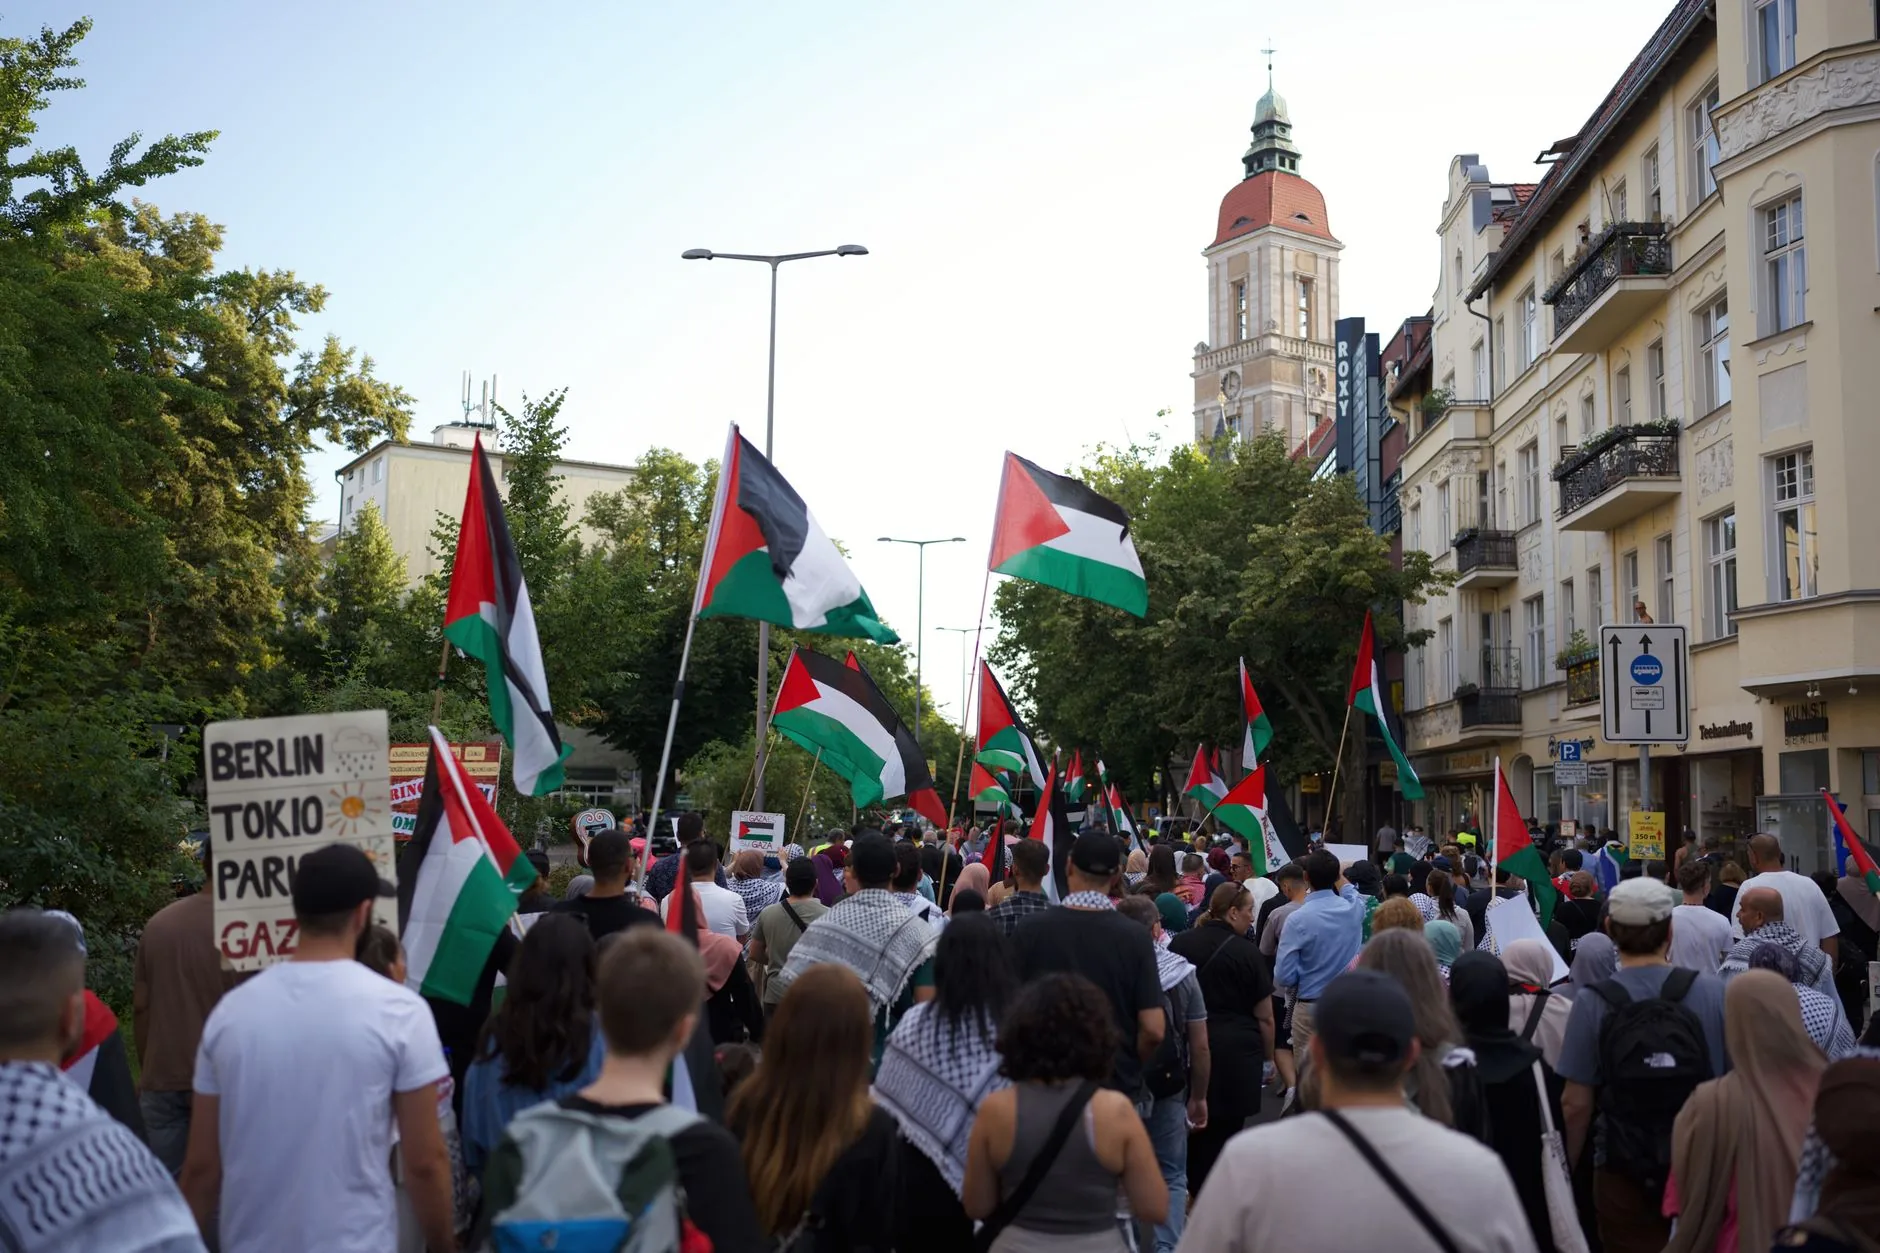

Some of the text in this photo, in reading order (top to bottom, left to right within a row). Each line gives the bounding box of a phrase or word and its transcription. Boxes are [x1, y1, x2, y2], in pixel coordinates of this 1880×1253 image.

[1338, 340, 1349, 417] ROXY
[1783, 701, 1827, 721] KUNST
[1699, 720, 1753, 740] Teehandlung
[211, 733, 324, 782] BERLIN
[1563, 744, 1575, 760] P
[211, 794, 324, 843] TOKIO
[749, 815, 768, 823] GAZA
[752, 841, 772, 850] GAZA
[218, 854, 295, 901] PARI
[221, 918, 299, 960] GAZ
